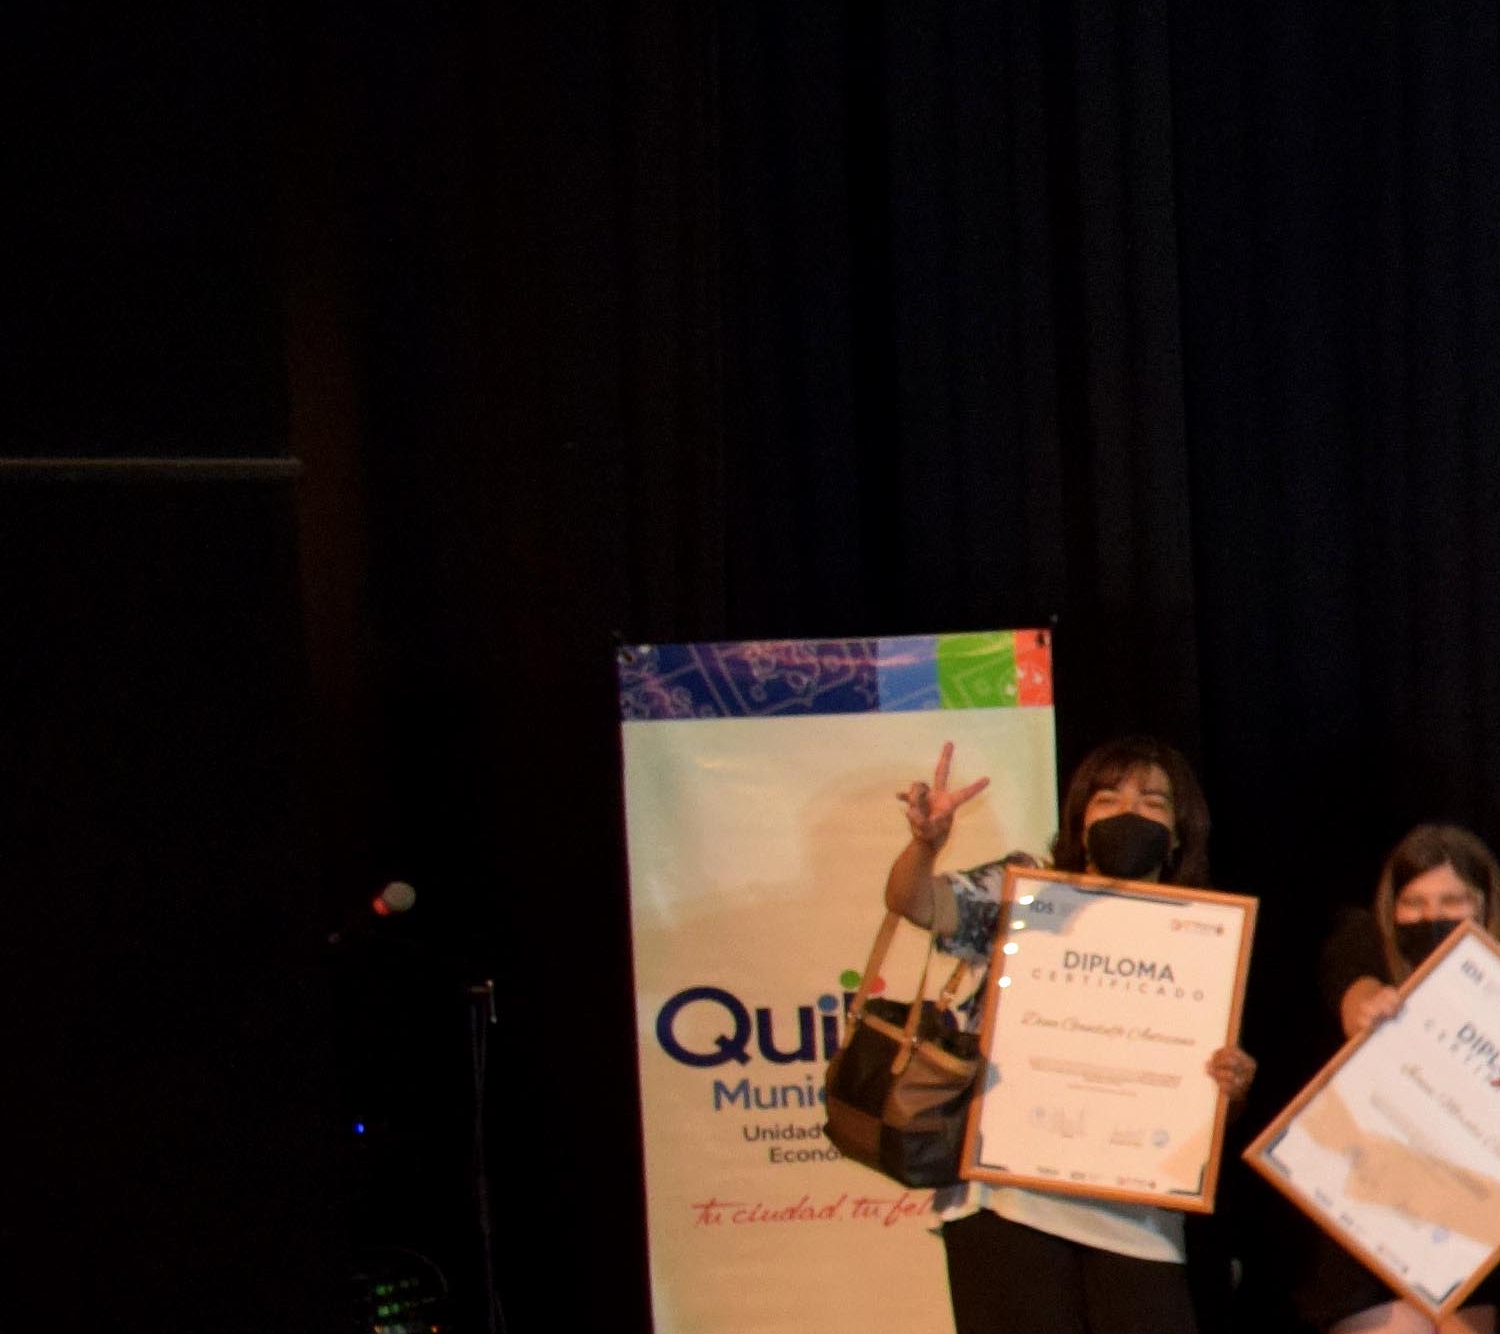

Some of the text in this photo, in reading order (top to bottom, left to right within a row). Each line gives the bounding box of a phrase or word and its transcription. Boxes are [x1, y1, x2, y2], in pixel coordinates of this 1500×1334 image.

[1031, 967, 1205, 1002] CERTIFICADO
[1063, 950, 1175, 984] DIPLOMA
[655, 985, 855, 1068] Qui
[712, 1075, 827, 1112] Muni
[742, 1123, 825, 1144] Unidad
[769, 1143, 848, 1165] Econó
[883, 1191, 936, 1228] fel
